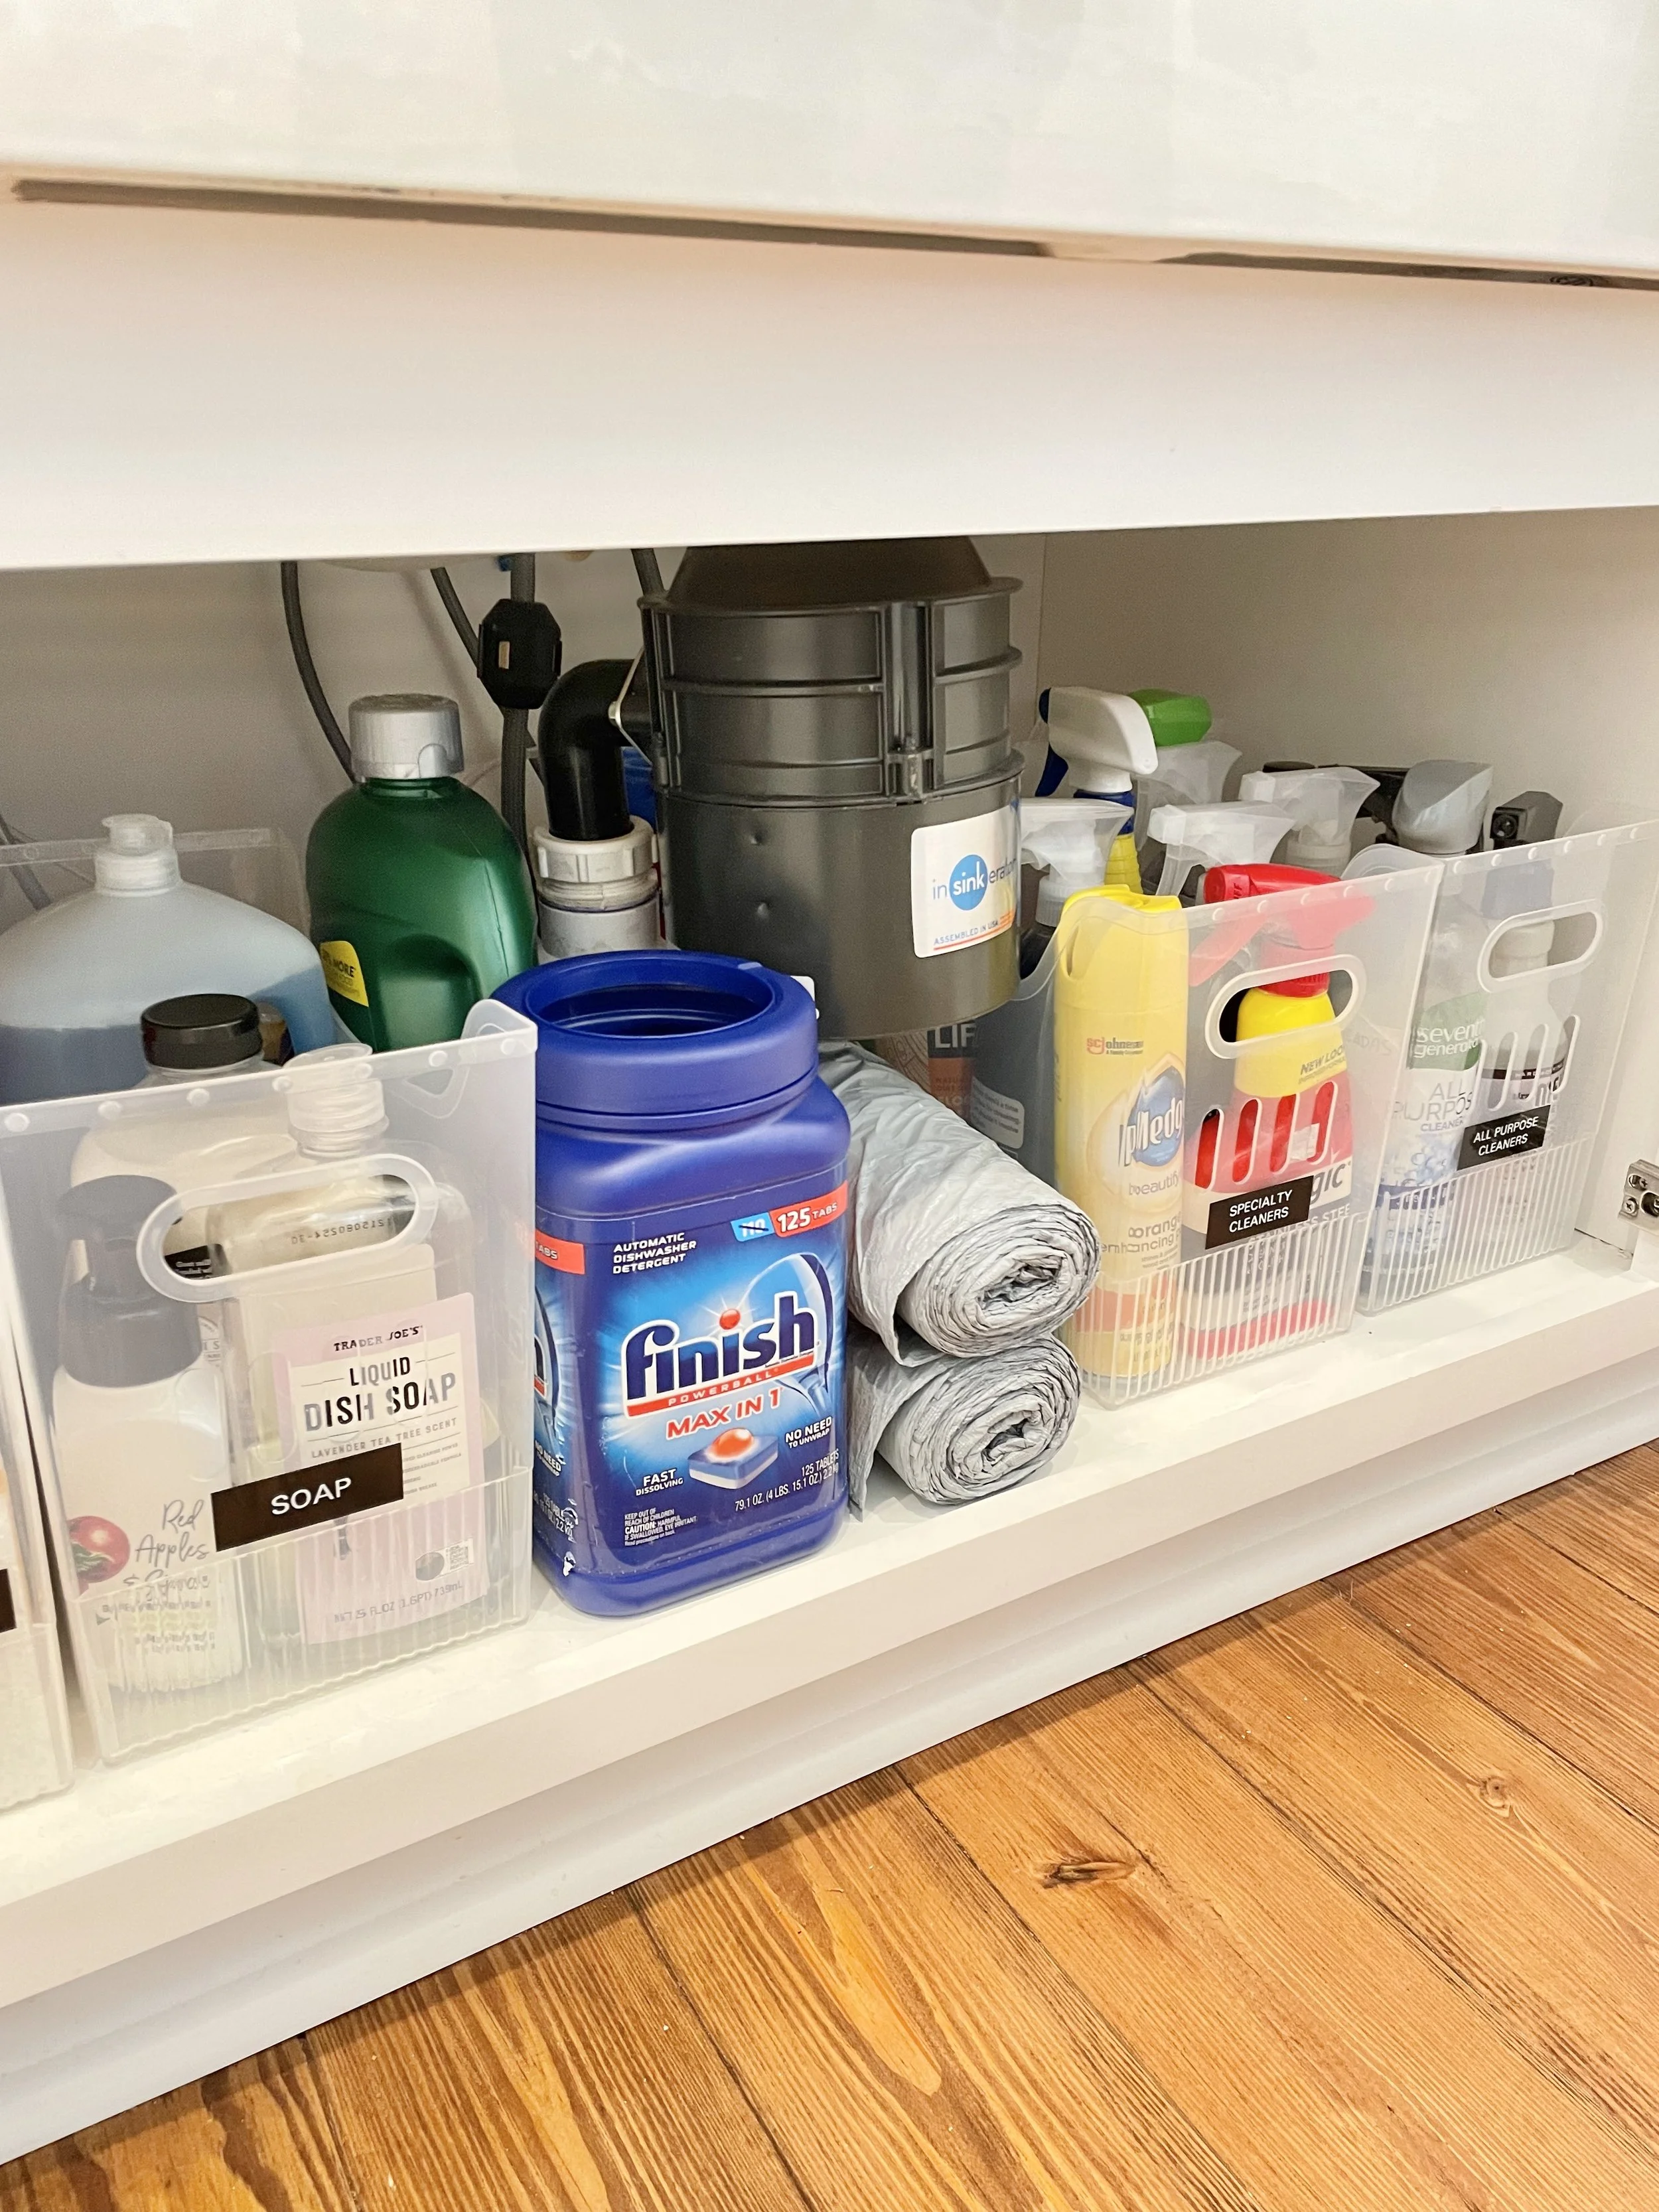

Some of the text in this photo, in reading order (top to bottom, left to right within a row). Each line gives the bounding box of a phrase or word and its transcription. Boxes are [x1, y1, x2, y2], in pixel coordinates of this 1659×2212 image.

[934, 927, 979, 945] ASSEMBLED
[979, 924, 986, 934] IN
[934, 1024, 977, 1049] LIF
[1473, 1116, 1539, 1143] ALL PURPOSE
[1478, 1134, 1529, 1156] CLEANERS
[1229, 1189, 1293, 1217] SPECIALTY
[777, 1207, 811, 1233] 125
[812, 1202, 838, 1220] TABS
[1228, 1206, 1289, 1233] CLEANERS
[613, 1232, 685, 1254] AUTOMATIC
[613, 1240, 697, 1264] DISHWASHER
[613, 1253, 686, 1274] DETERGENT
[334, 1326, 420, 1351] TRADER JOE'S
[622, 1291, 817, 1402] finish
[349, 1357, 411, 1386] LIQUID
[304, 1372, 457, 1432] DISH SOAP
[668, 1370, 772, 1407] POWERBALL
[666, 1386, 782, 1440] MAX IN 1
[311, 1417, 457, 1459] LAVENDER TEA TREE SCENT
[785, 1416, 832, 1443] NO NEED
[788, 1428, 830, 1449] TO UNWRAP
[801, 1449, 839, 1477] 125 TABLETS
[636, 1477, 684, 1497] DISSOLVING
[643, 1468, 677, 1487] FAST
[271, 1477, 352, 1515] SOAP
[735, 1497, 751, 1511] 79.1
[752, 1493, 764, 1506] OZ.
[766, 1490, 774, 1503] (4
[774, 1484, 790, 1499] LBS.
[792, 1477, 807, 1491] 15.1
[162, 1499, 205, 1534] Red
[624, 1517, 642, 1527] REACH
[650, 1509, 675, 1521] CHILDREN
[638, 1509, 649, 1518] OUT
[624, 1521, 657, 1534] CAUTION:
[135, 1531, 210, 1569] Apples
